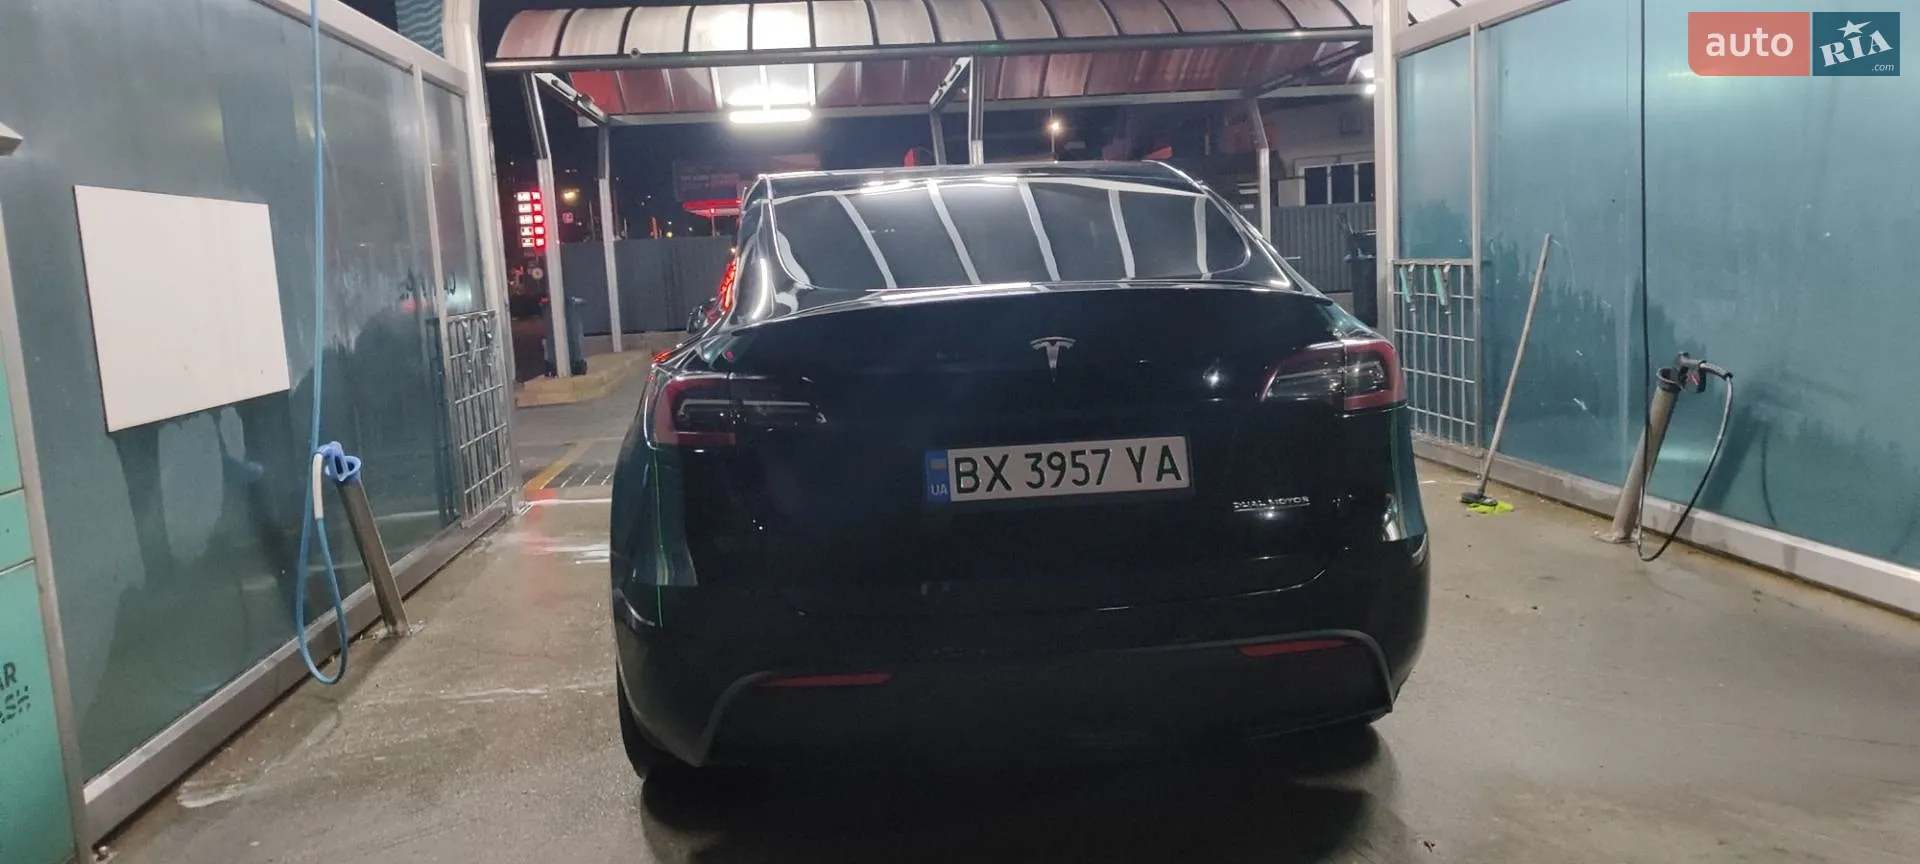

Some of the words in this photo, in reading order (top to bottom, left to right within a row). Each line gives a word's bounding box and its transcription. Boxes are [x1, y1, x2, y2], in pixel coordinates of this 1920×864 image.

[931, 483, 948, 496] UA
[954, 454, 1012, 494] BX
[1024, 449, 1112, 489] 3957
[1125, 445, 1183, 483] YA
